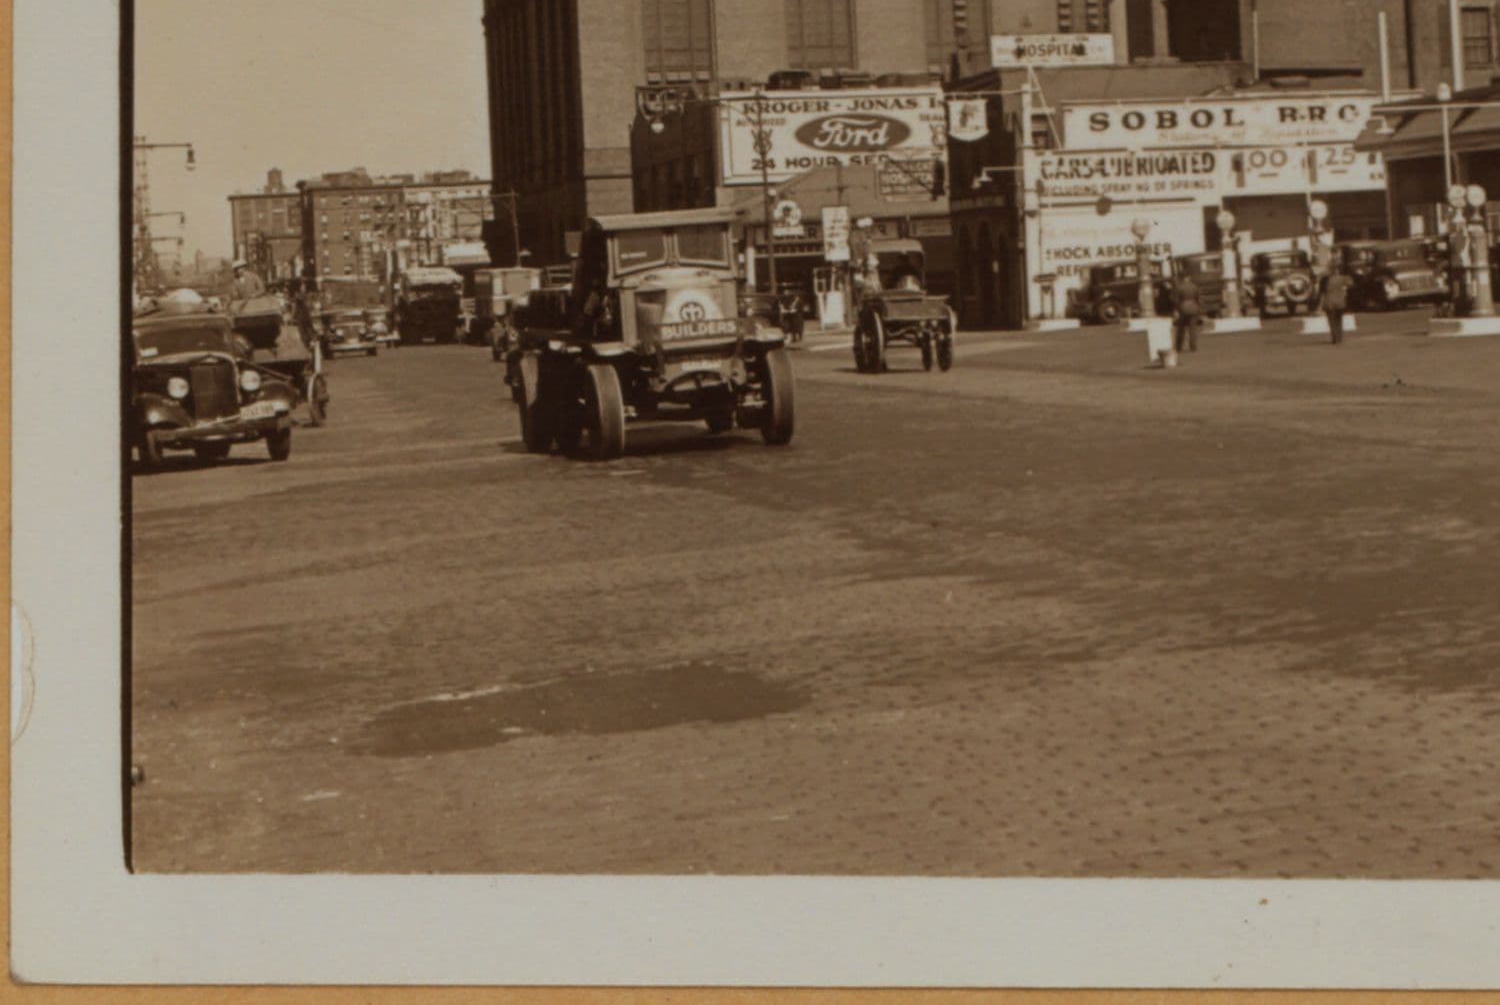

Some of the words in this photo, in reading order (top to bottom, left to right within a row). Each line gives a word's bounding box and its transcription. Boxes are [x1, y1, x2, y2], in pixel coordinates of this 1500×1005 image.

[743, 98, 831, 115] KROGER
[847, 96, 918, 112] JONAS
[1088, 106, 1244, 132] SOBOL
[814, 116, 890, 147] Ford
[751, 157, 776, 171] 24
[785, 155, 839, 169] HOUR
[1102, 181, 1150, 194] SPRAYNG
[661, 321, 737, 340] BUILDERS
